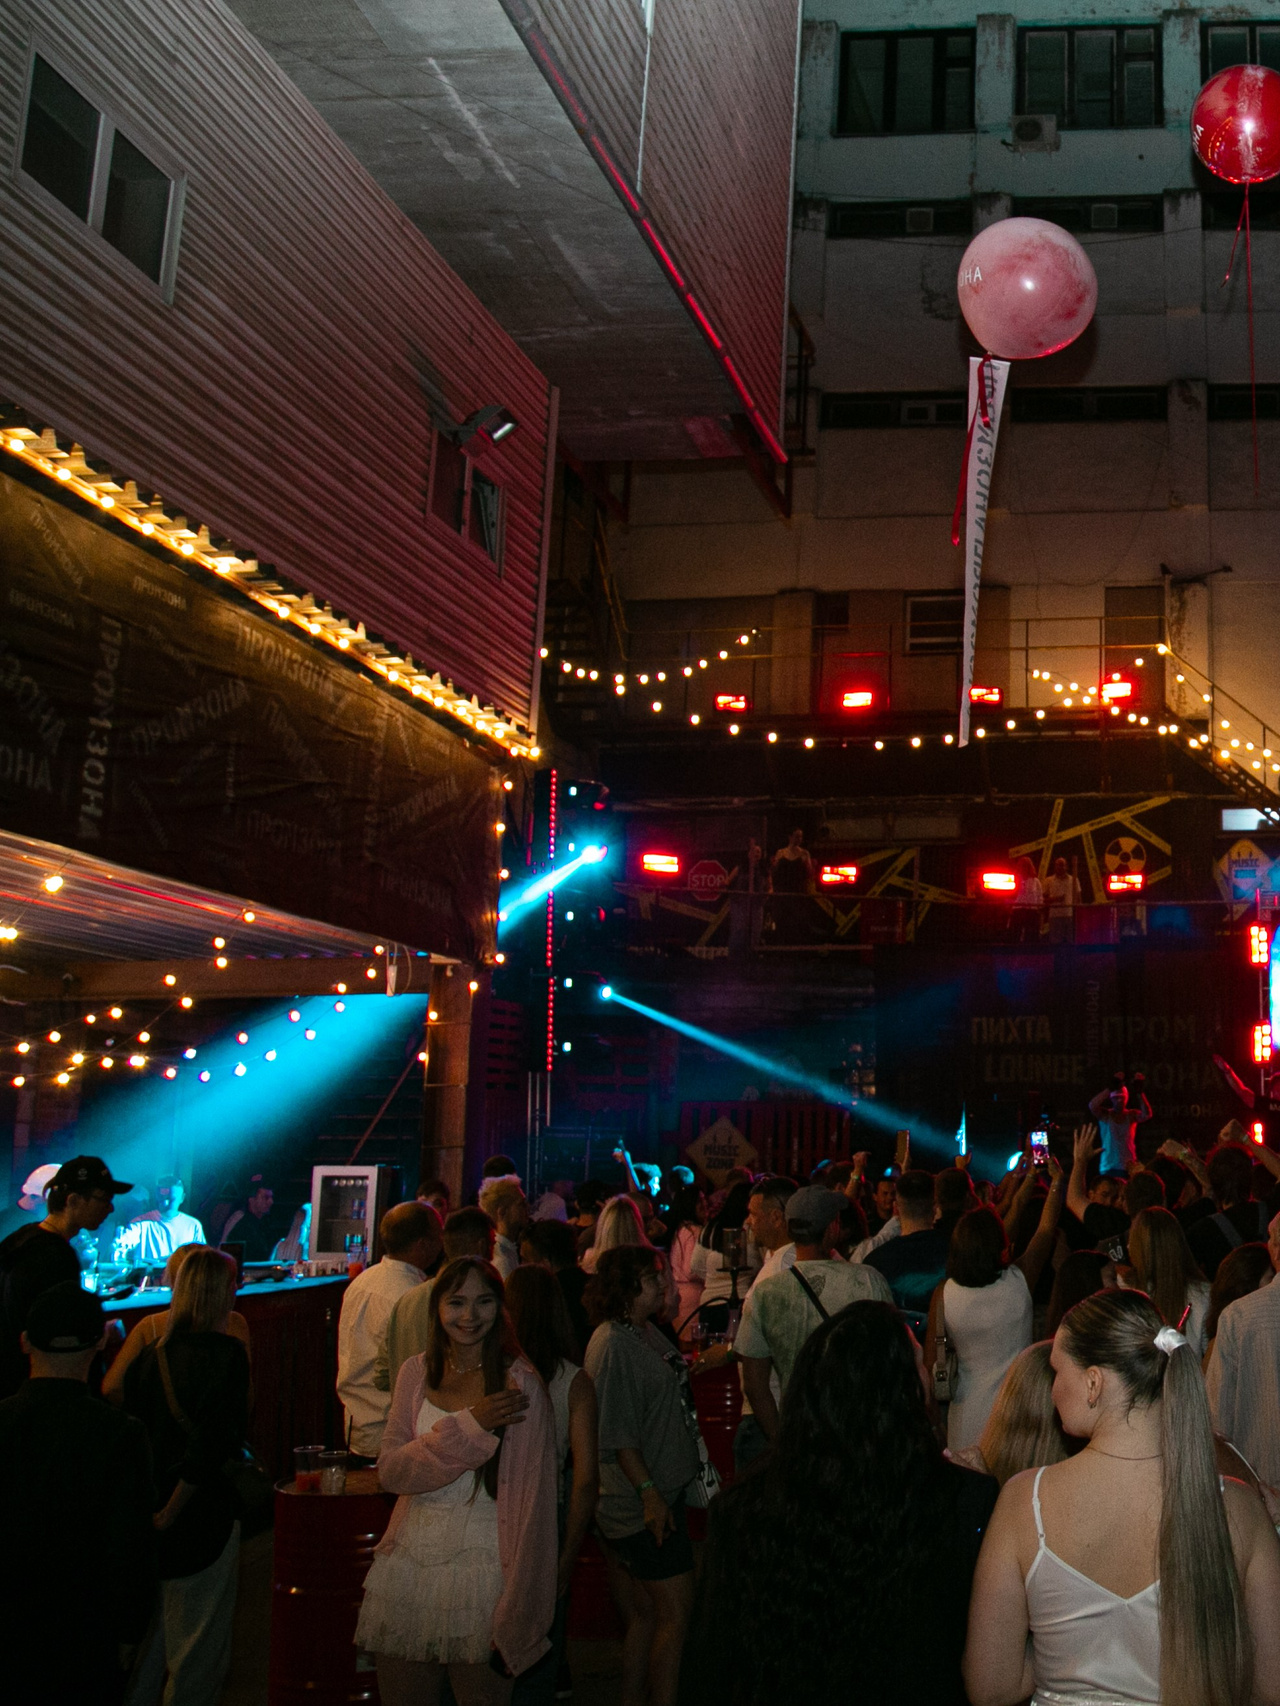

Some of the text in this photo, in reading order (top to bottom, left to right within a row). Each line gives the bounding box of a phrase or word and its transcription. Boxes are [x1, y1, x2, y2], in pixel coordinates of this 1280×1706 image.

[691, 873, 725, 888] STOP
[971, 1015, 1053, 1045] ПИХТА
[1102, 1014, 1197, 1045] ПРОМ
[984, 1054, 1086, 1085] LOUNGE
